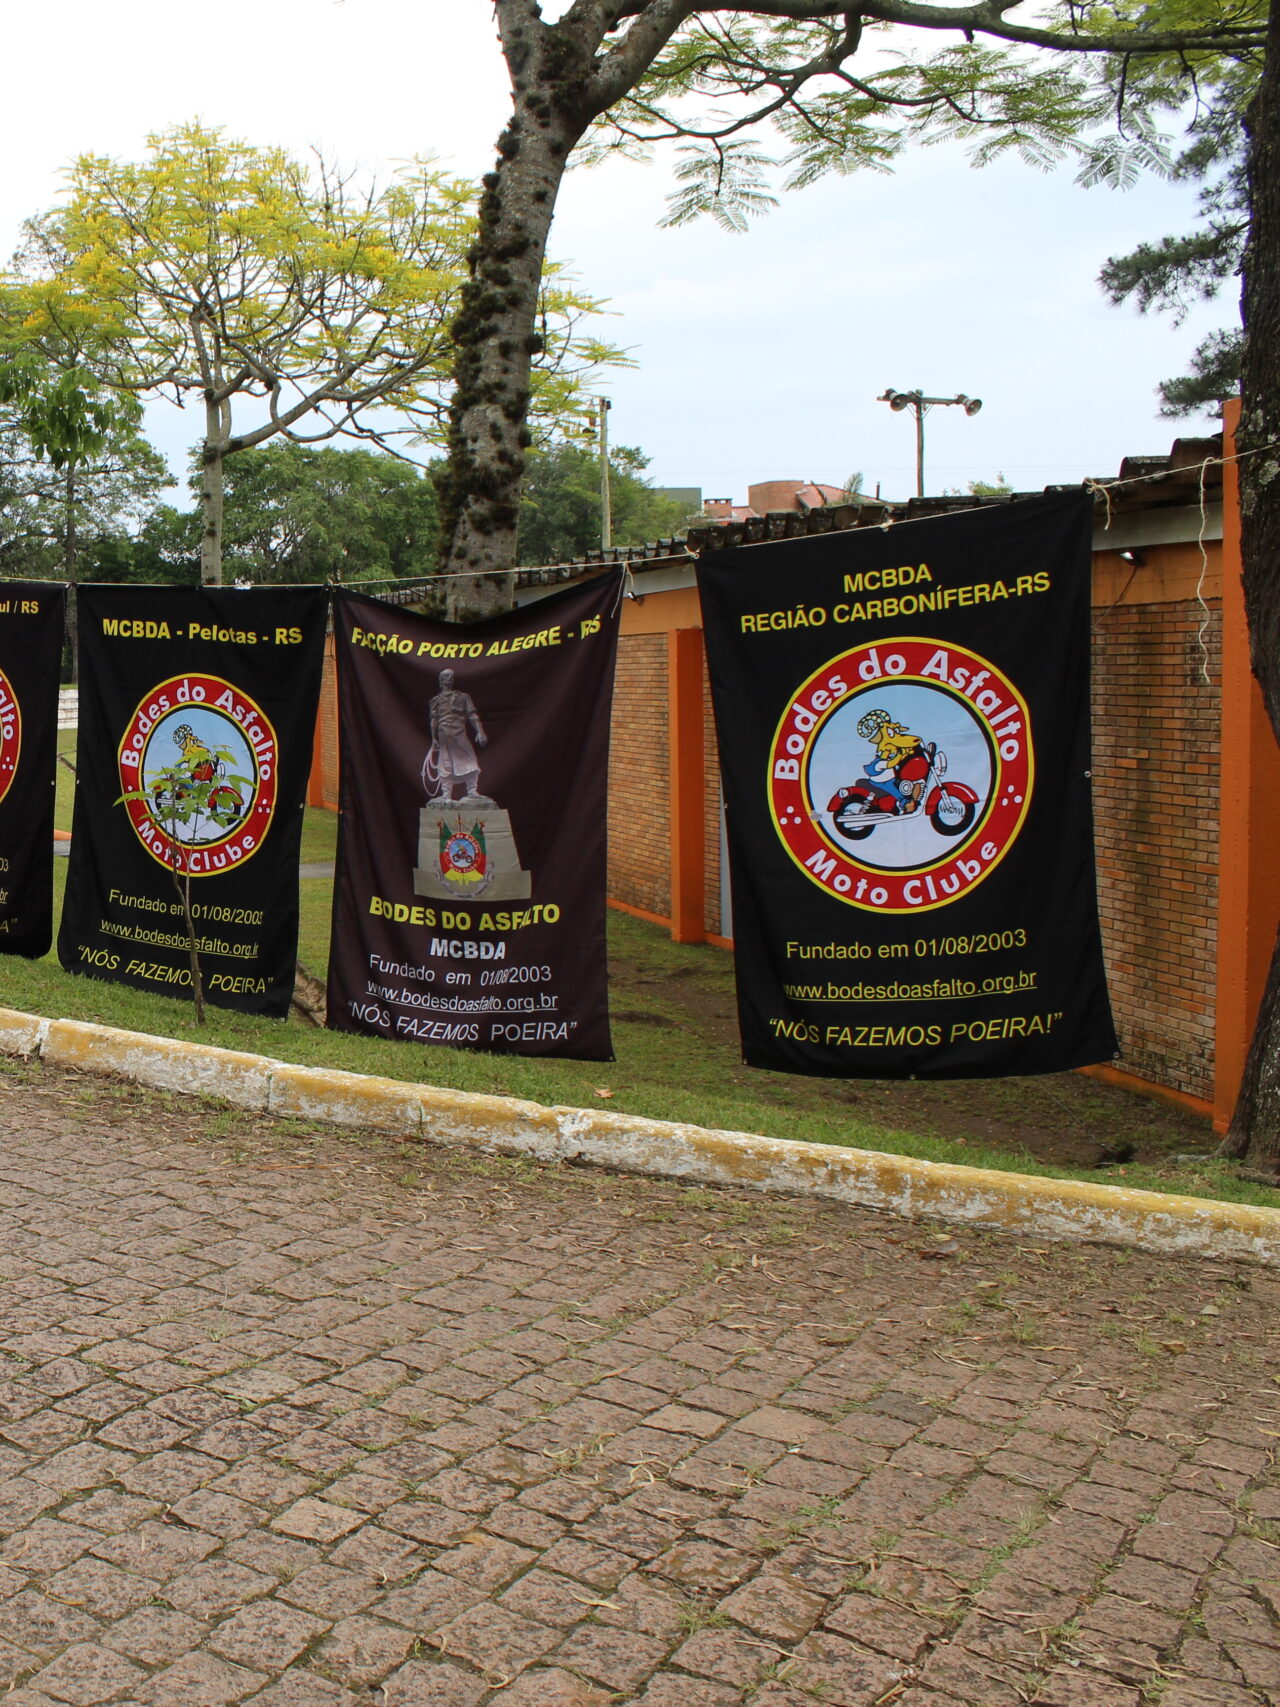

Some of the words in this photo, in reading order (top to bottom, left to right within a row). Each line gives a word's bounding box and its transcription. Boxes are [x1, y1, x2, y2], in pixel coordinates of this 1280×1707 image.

[843, 563, 933, 593] MCBDA
[21, 601, 39, 614] RS
[741, 604, 827, 634] REGIÃO
[833, 571, 1051, 625] CARBONÍFERA-RS
[102, 619, 171, 640] MCBDA
[188, 623, 257, 645] Pelotas
[275, 627, 303, 645] RS
[417, 641, 483, 658] PORTO
[486, 626, 561, 656] ALEGRE
[121, 695, 170, 768] Bodes
[176, 679, 206, 703] do
[215, 689, 273, 780] Asfalto
[774, 674, 848, 781] Bodes
[858, 648, 907, 679] do
[920, 650, 1021, 762] Asfalto
[190, 835, 255, 871] Clube
[804, 848, 888, 905] Moto
[903, 841, 997, 905] Clube
[109, 889, 167, 913] Fundado
[369, 896, 436, 927] BODES
[442, 912, 471, 931] DO
[479, 904, 560, 931] ASFALTO
[430, 938, 506, 960] MCBDA
[786, 941, 872, 959] Fundado
[878, 943, 909, 958] em
[914, 929, 1027, 958] 01/08/2003
[370, 953, 436, 983] Fundado
[446, 970, 470, 985] em
[480, 966, 552, 987] 01/08/2003
[783, 970, 1038, 1001] www.bodesdoasfalto.org.br
[397, 1016, 479, 1041] FAZEMOS
[826, 1025, 942, 1047] FAZEMOS
